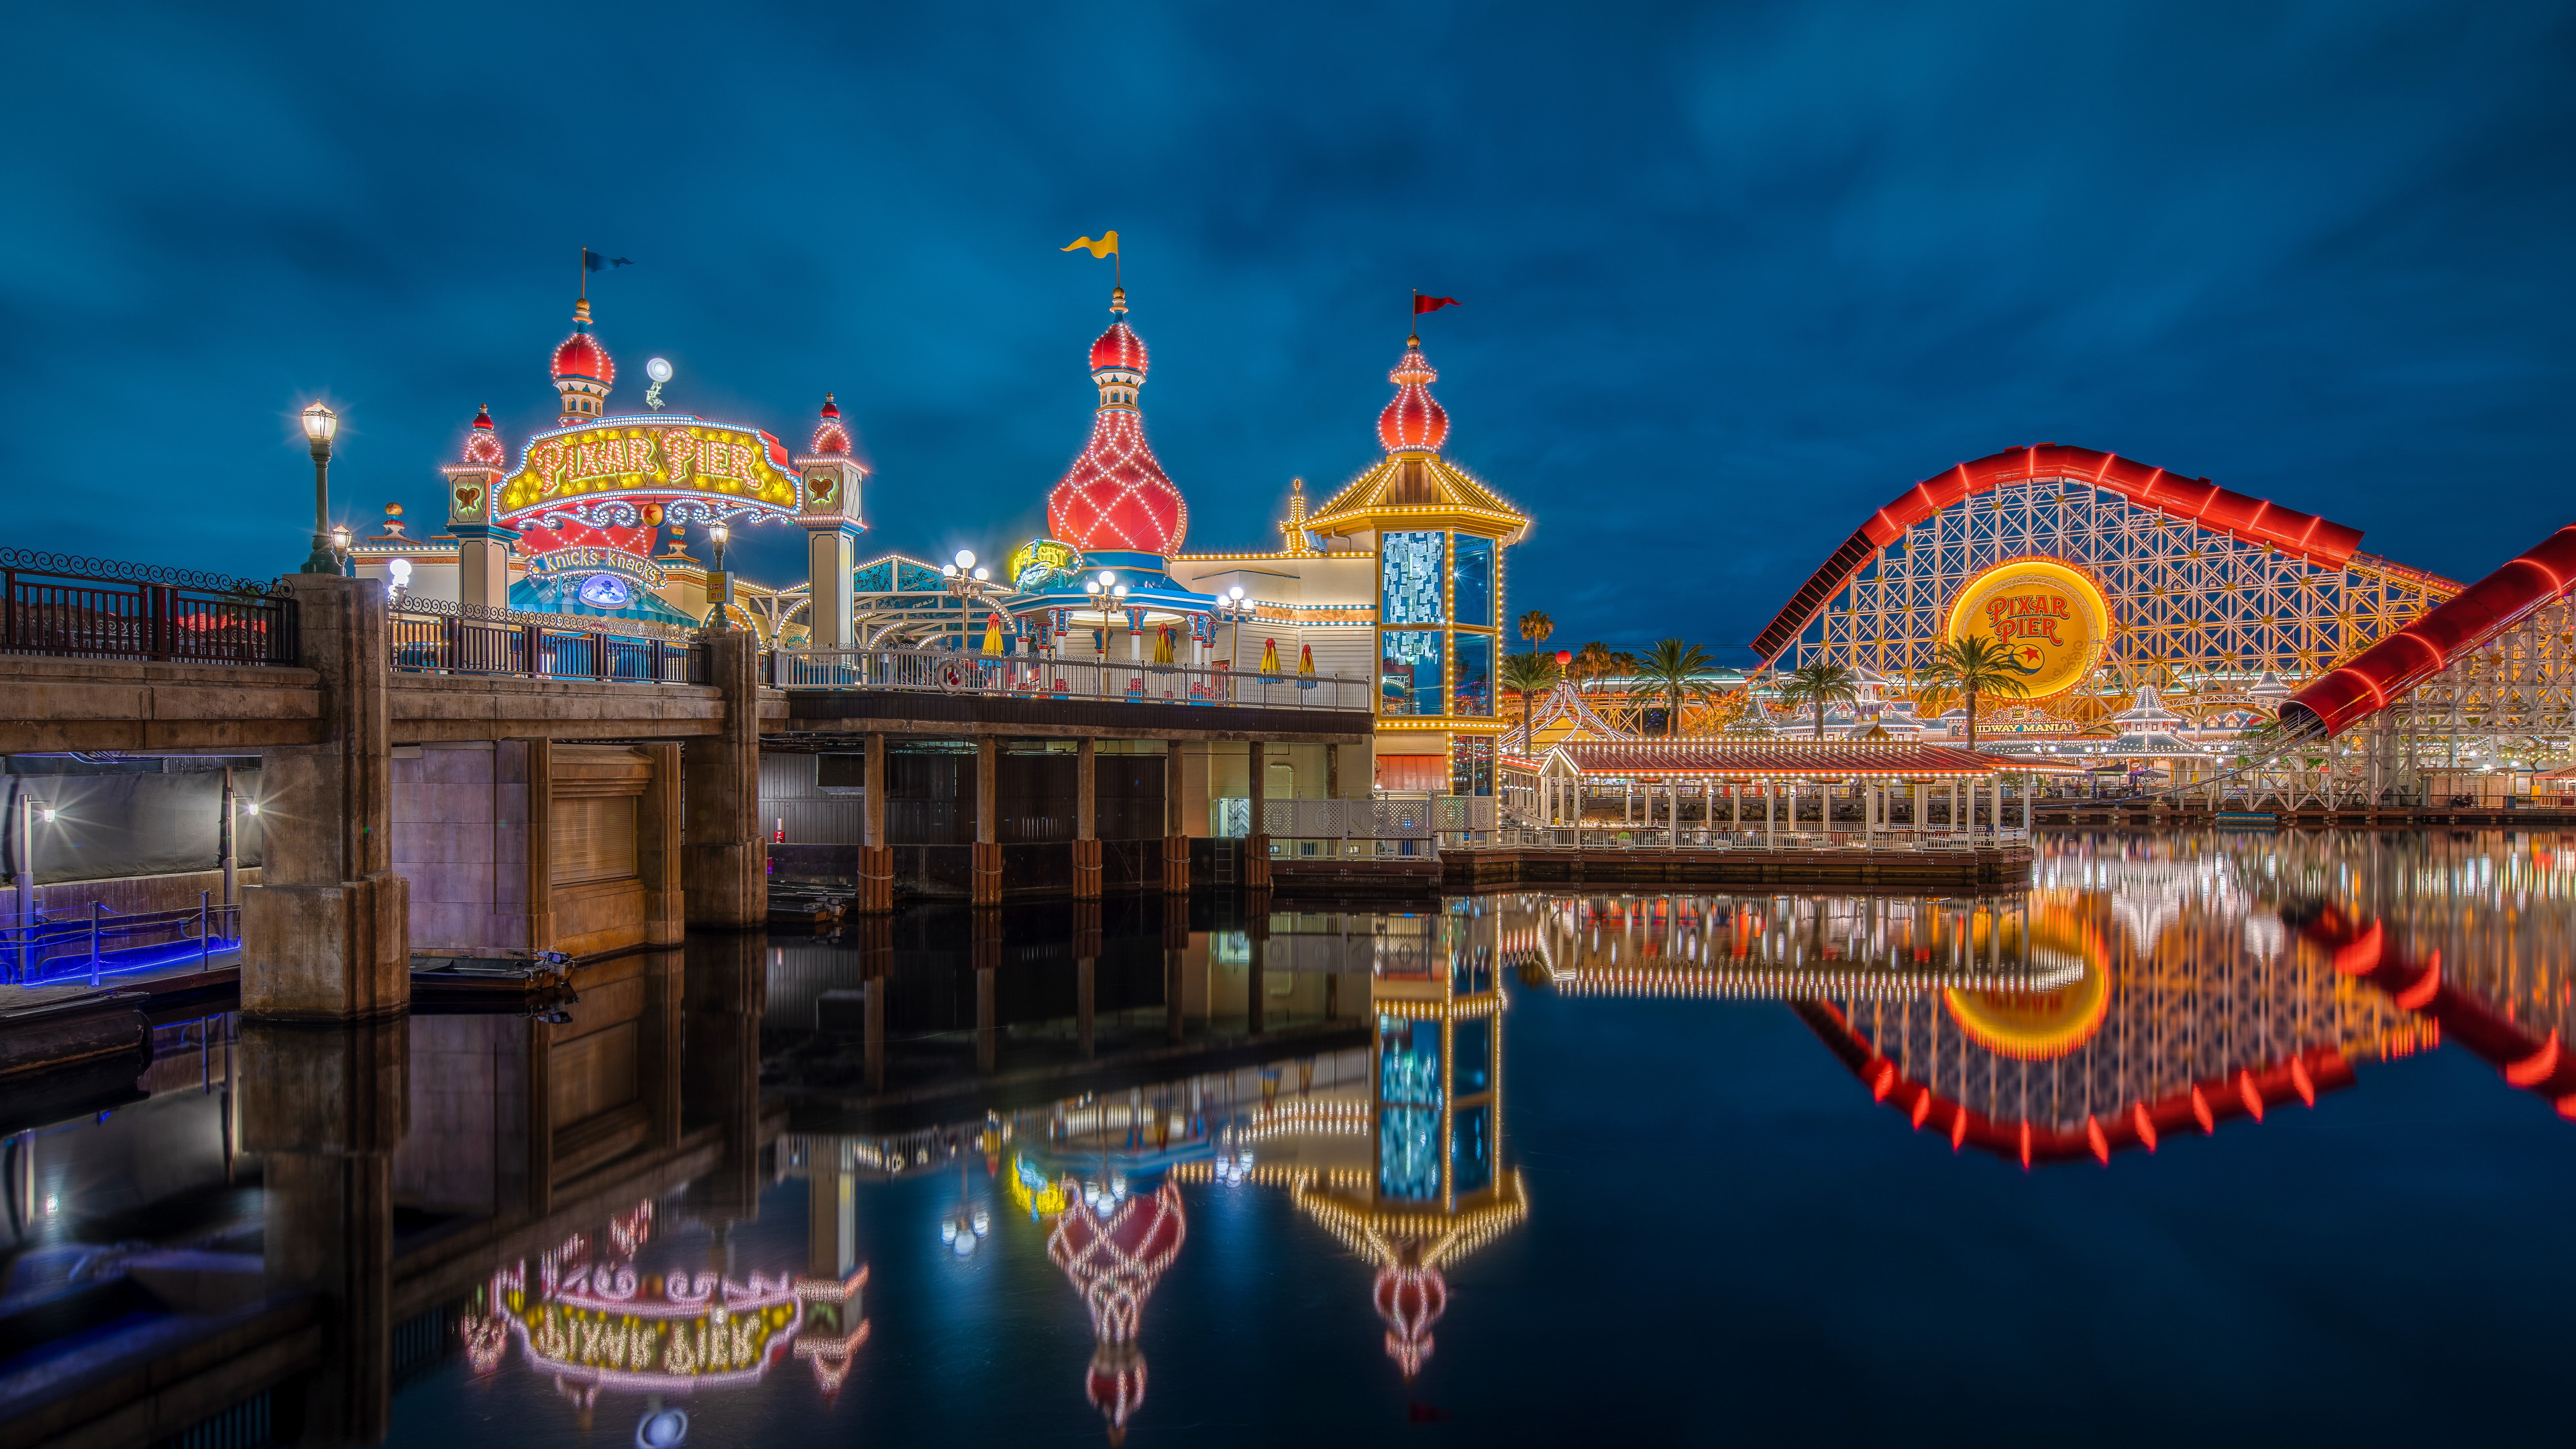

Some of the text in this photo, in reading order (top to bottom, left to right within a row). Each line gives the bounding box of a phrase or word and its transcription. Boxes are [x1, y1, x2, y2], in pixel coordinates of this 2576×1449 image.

[533, 430, 762, 494] PIXAR PIER
[1986, 595, 2070, 628] PIXAR
[1994, 616, 2063, 647] PIER
[1976, 723, 2072, 733] IDWAY MANIA!
